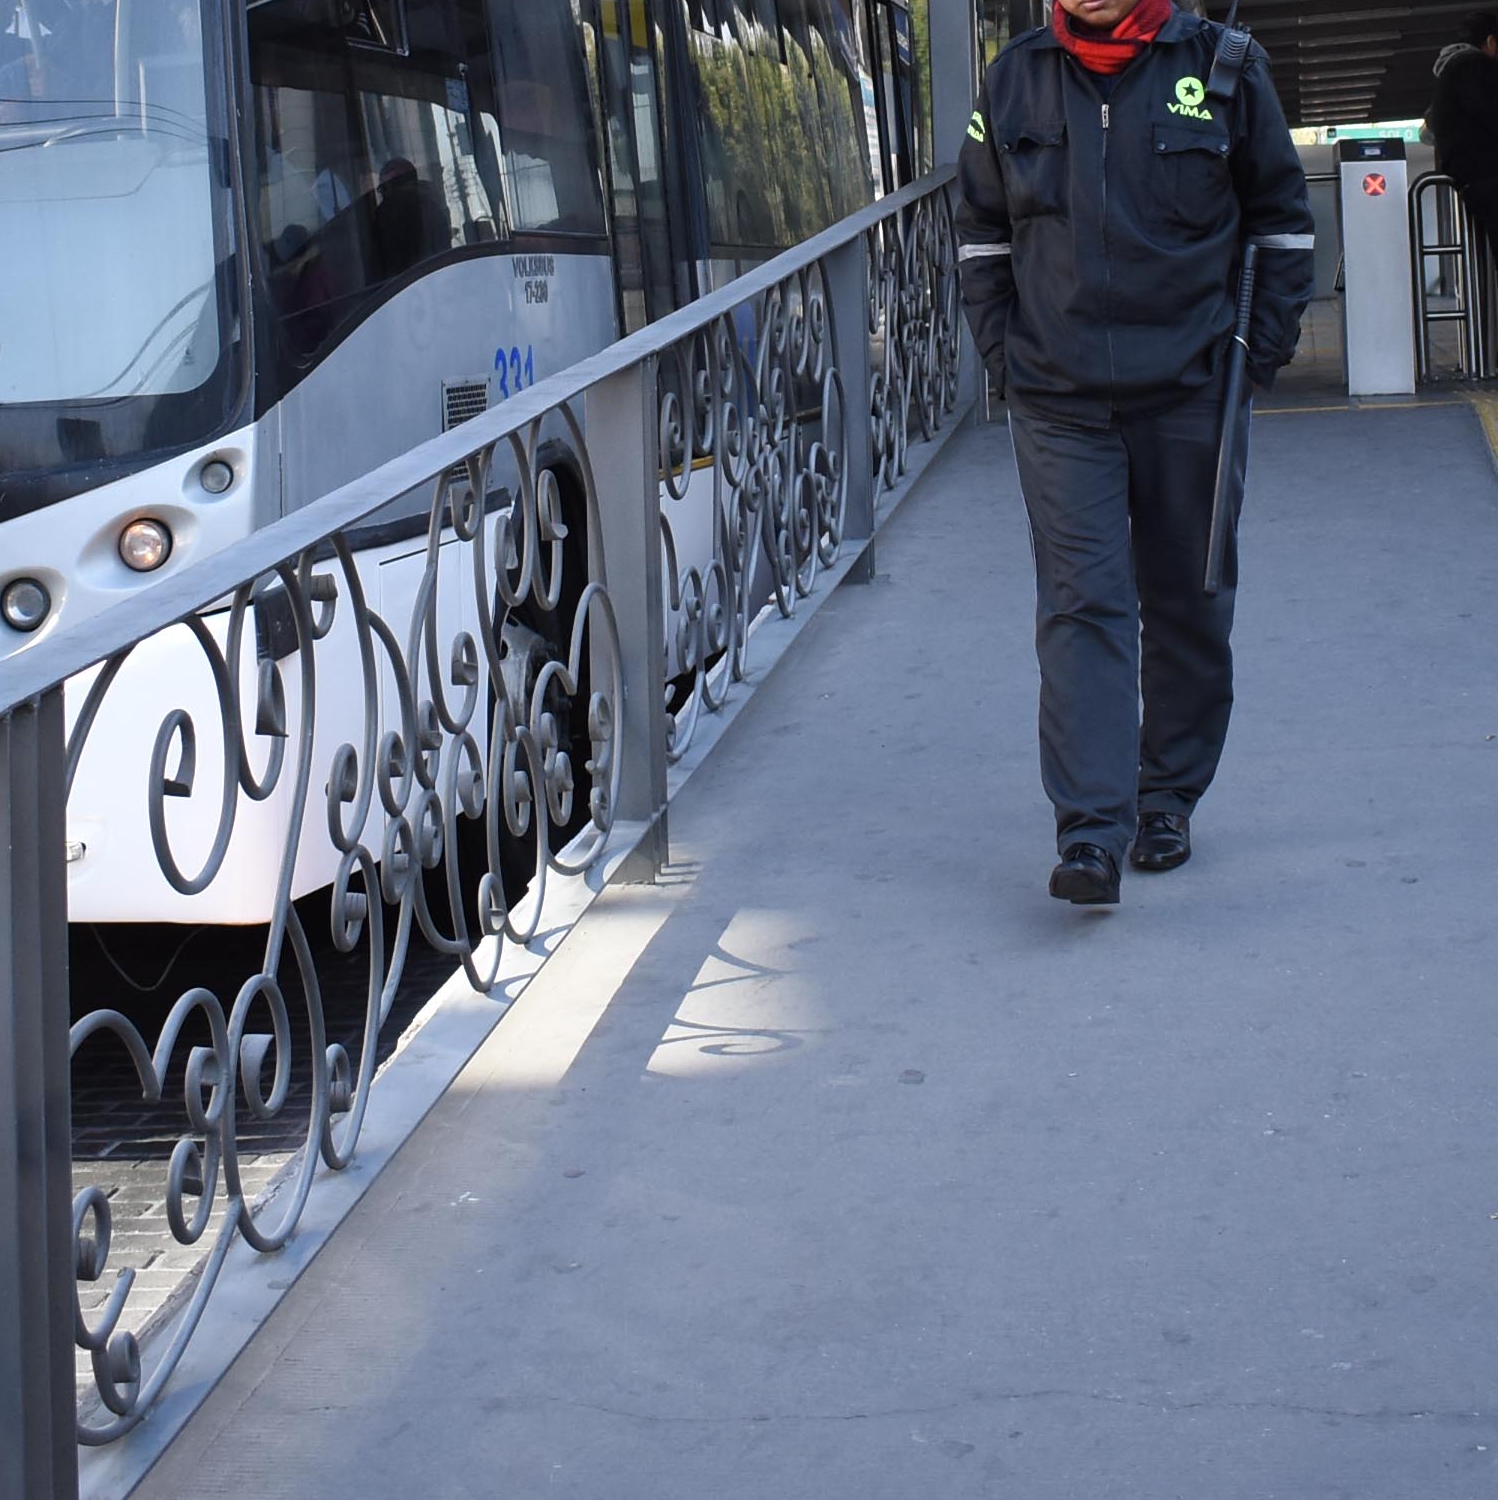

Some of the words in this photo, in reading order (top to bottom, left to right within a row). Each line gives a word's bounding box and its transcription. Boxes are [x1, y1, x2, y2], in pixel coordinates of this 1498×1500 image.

[1166, 102, 1214, 120] VIMA
[511, 255, 555, 279] VOLKSBUS
[494, 343, 535, 400] 331
